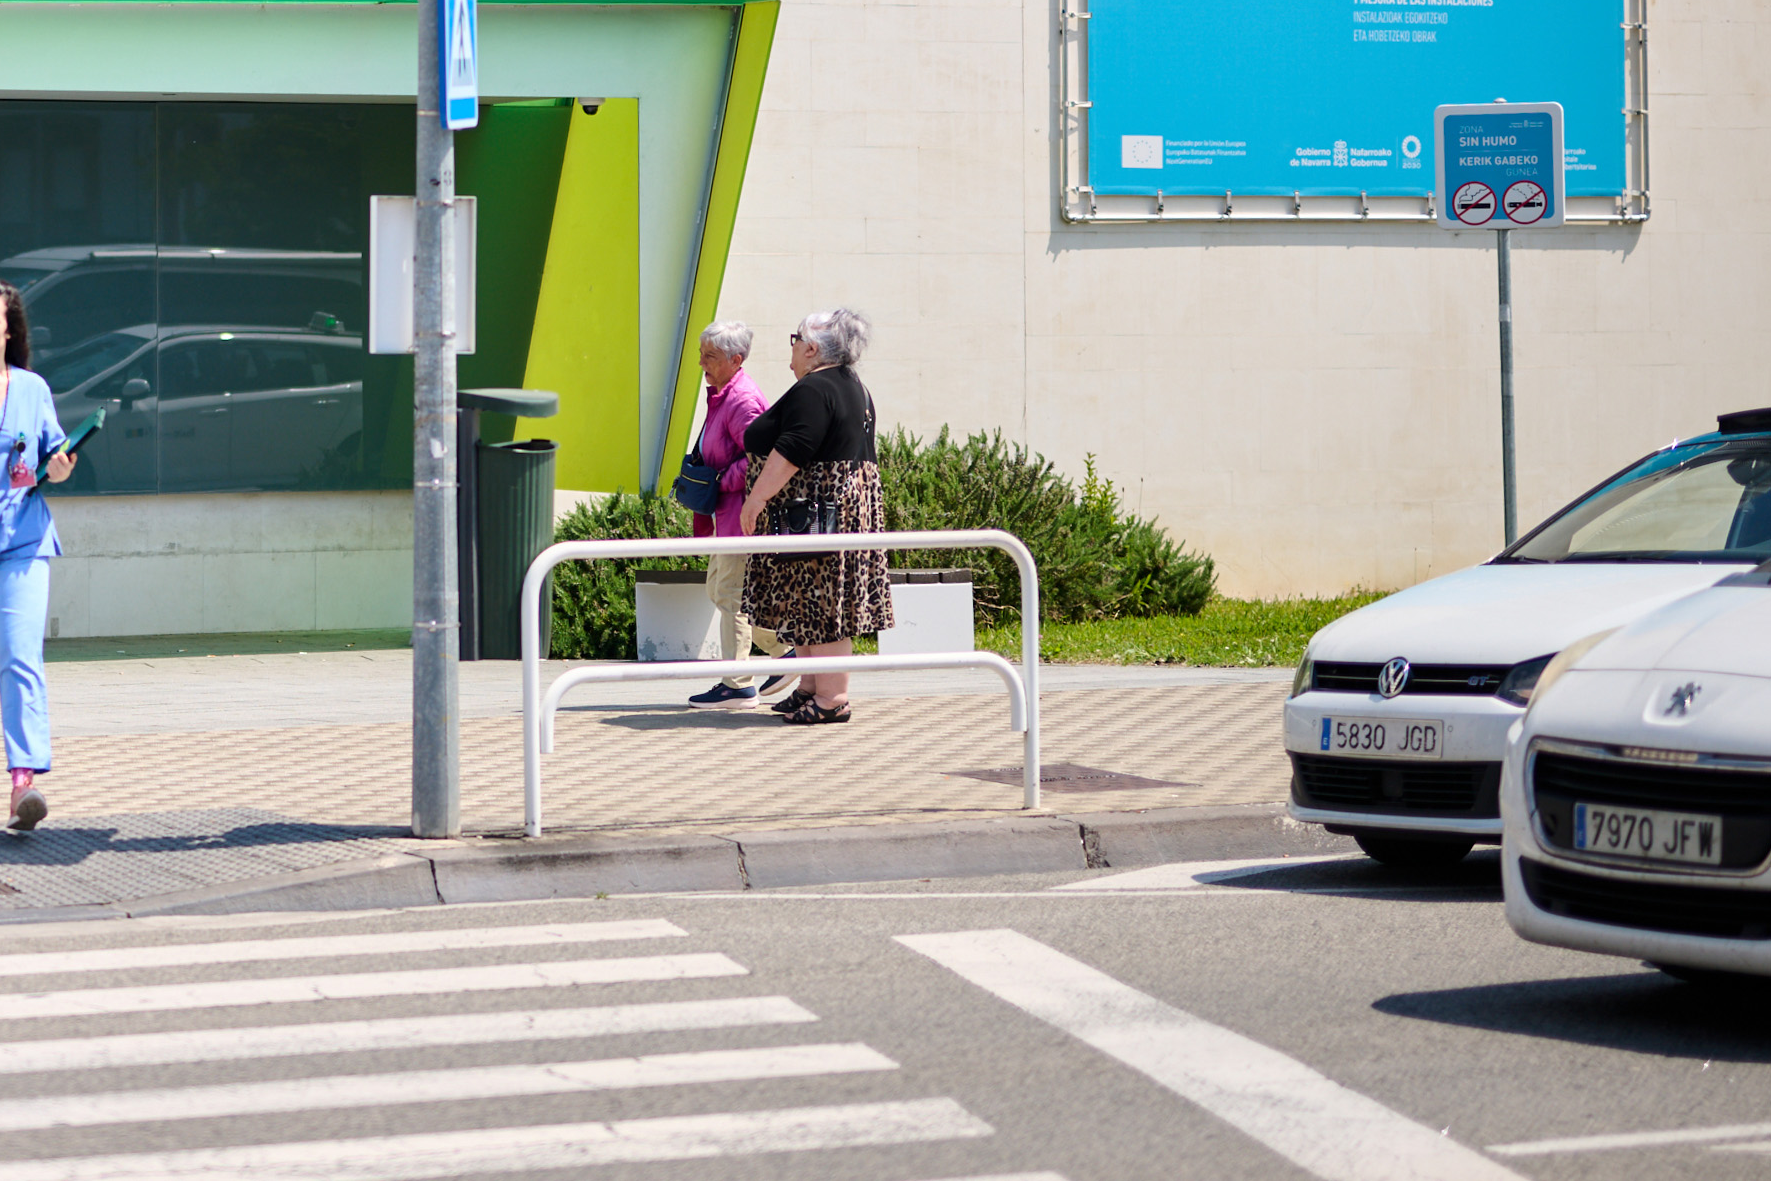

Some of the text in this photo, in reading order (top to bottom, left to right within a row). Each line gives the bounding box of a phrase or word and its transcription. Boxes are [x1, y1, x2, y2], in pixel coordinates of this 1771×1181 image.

[1354, 29, 1367, 42] ETA
[1412, 31, 1437, 42] OBRAK
[1459, 125, 1484, 134] ZONA
[1459, 135, 1517, 147] SIN HUMO
[1296, 147, 1392, 156] Gobierno Nafarroako
[1290, 158, 1387, 167] de Navarra Gobernua
[1459, 155, 1538, 167] KERIK GABEKO
[1505, 168, 1538, 177] GUNEA
[1337, 722, 1386, 750] 5830
[1398, 725, 1437, 752] JGD
[1592, 811, 1715, 858] 7970 JFW
